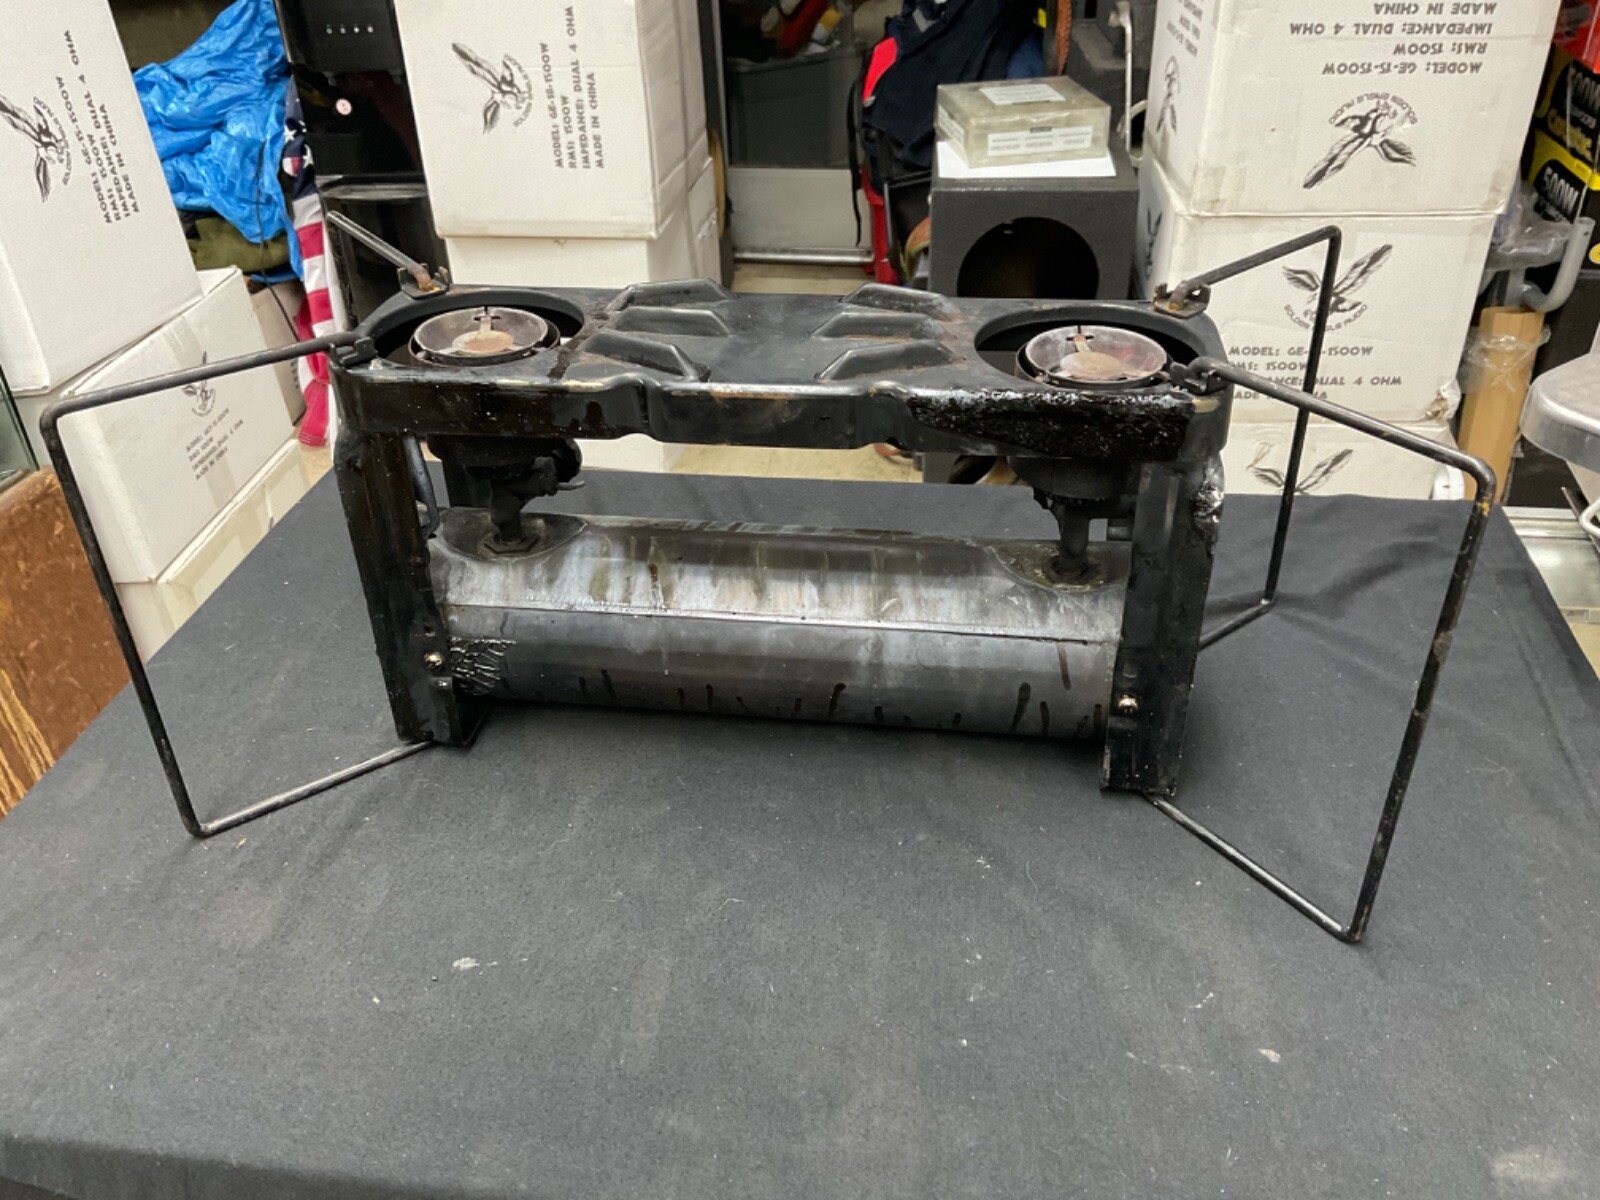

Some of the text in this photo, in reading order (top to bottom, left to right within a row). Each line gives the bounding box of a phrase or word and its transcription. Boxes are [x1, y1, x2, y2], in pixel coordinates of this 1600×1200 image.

[1290, 23, 1493, 35] IMPEDANCE: DUAL 4 OHM
[1374, 3, 1497, 15] MADE IN CHINA
[1322, 62, 1482, 74] MODEL: GE-15-1500W
[1393, 43, 1488, 55] RMS: 1500W
[565, 6, 591, 169] IMPEDANCE: DUAL 4 OHM
[64, 30, 130, 217] IMPEDANCE: DUAL 4 OHM
[560, 95, 577, 169] RMS: 1500W
[586, 72, 604, 169] MADE IN CHINA
[98, 104, 139, 213] MADE IN CHINA
[551, 125, 564, 168] MODEL:
[87, 133, 122, 221] RMS: 1500W
[91, 171, 112, 224] MODEL:
[1544, 166, 1578, 215] 500W
[1228, 346, 1373, 357] MODEL: GE--1500W
[1233, 391, 1260, 400] ADE
[1353, 376, 1363, 386] 4
[1370, 376, 1402, 387] OHM
